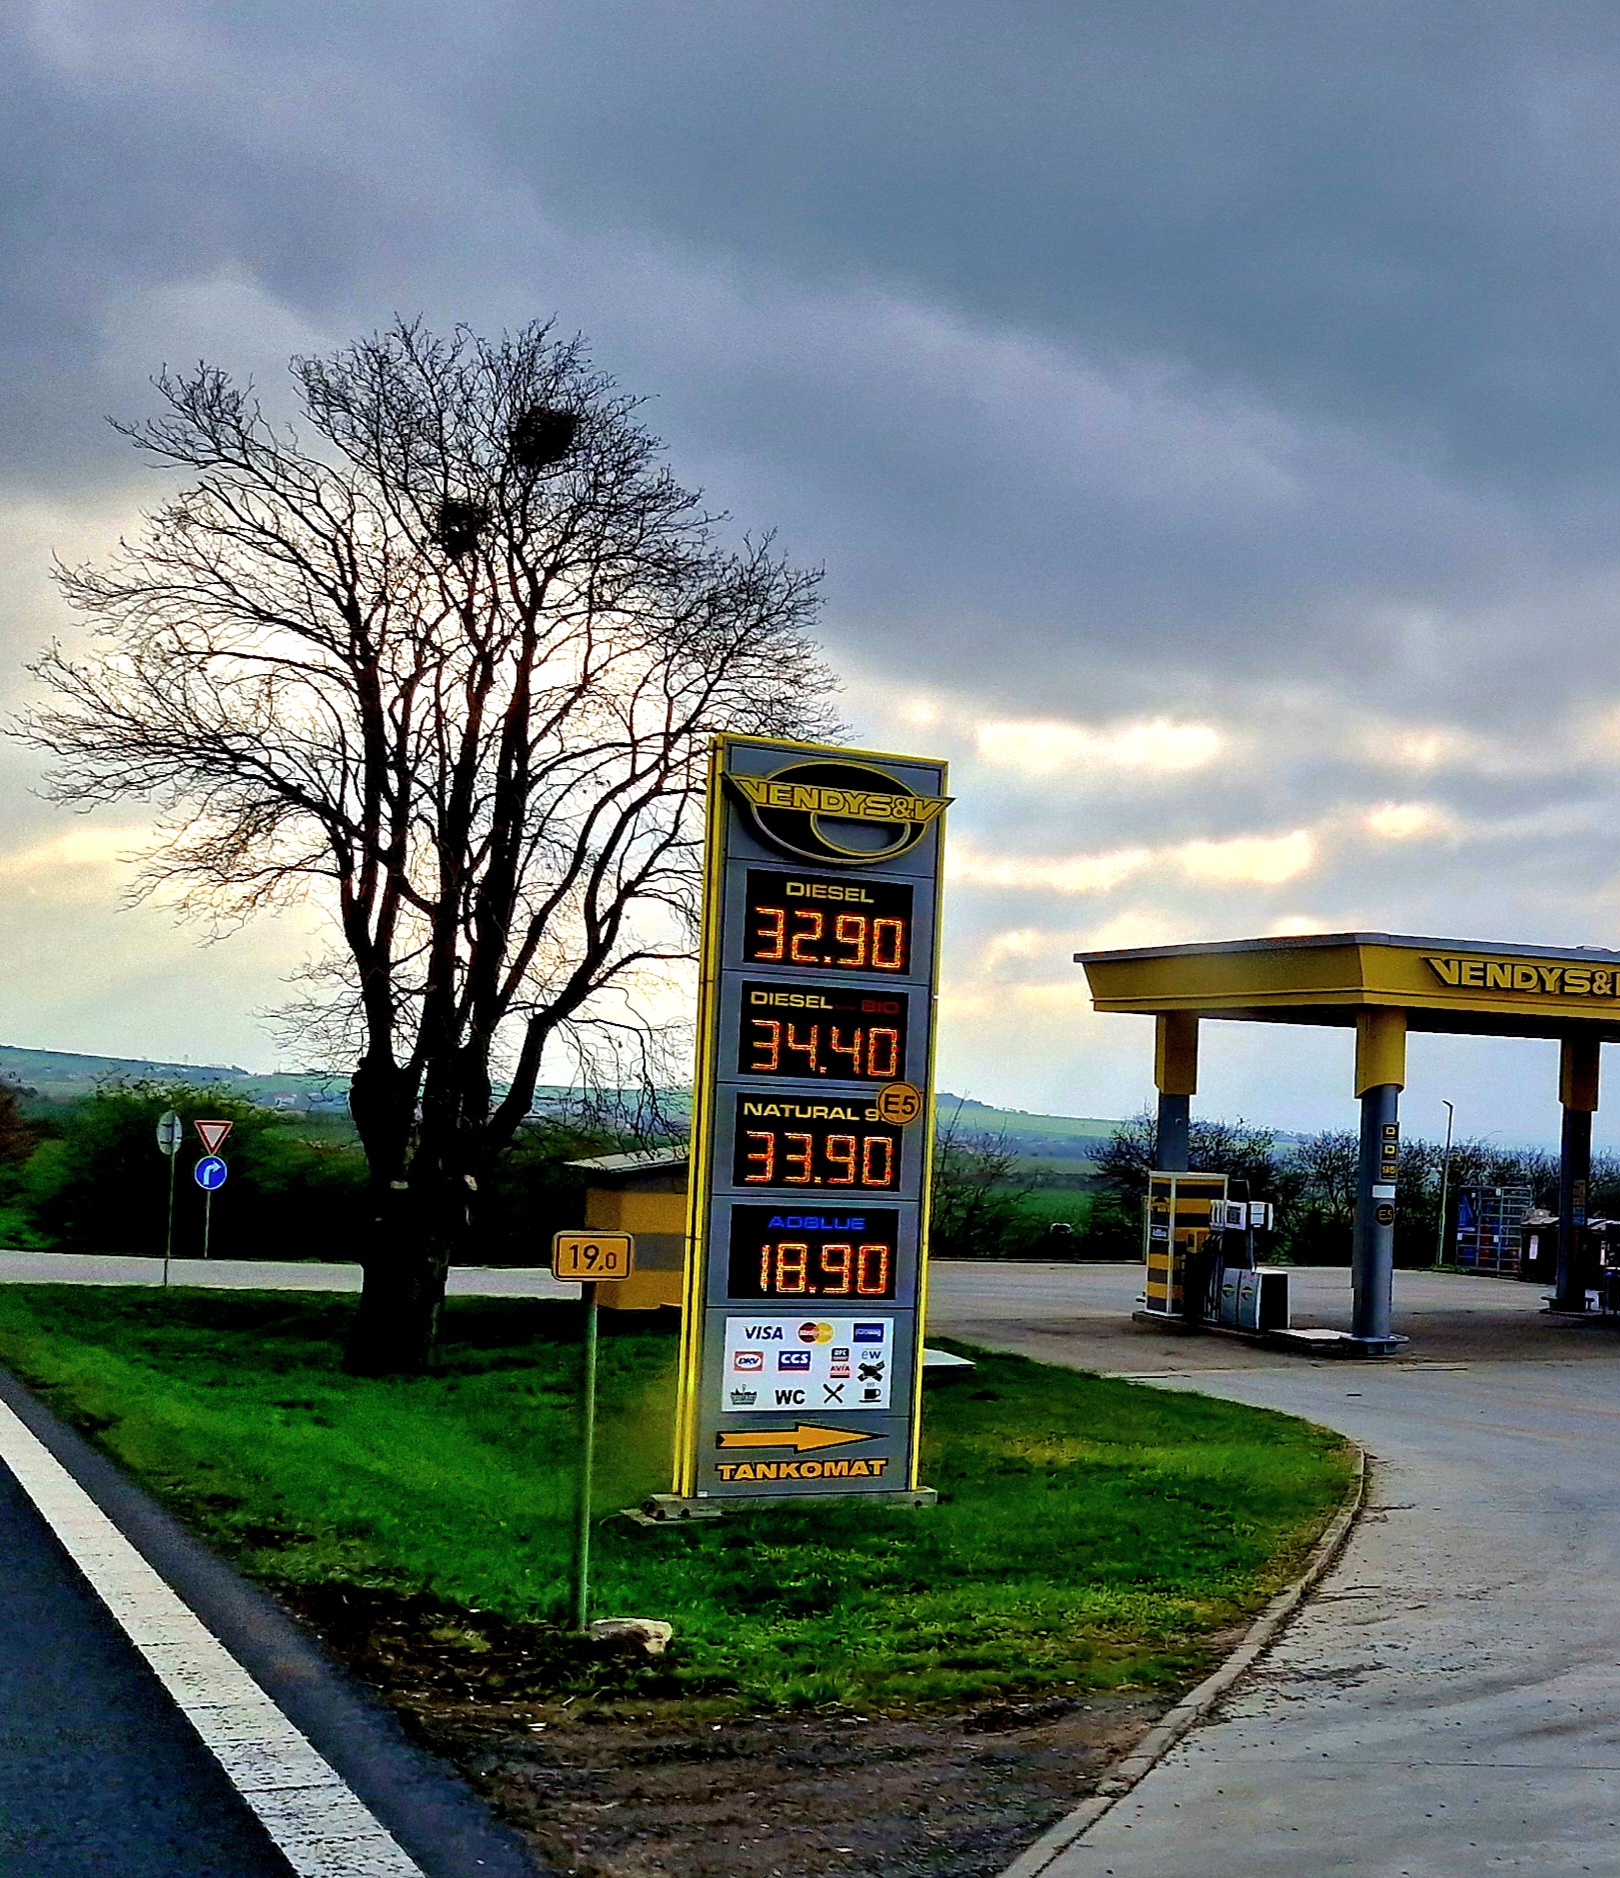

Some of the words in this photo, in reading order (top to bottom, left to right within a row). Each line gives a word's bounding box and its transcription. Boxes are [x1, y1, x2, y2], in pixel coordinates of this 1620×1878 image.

[737, 779, 942, 821] VENDYS&V
[786, 881, 874, 903] DIESEL
[754, 906, 903, 968] 32.90
[750, 991, 833, 1010] DIESEL
[860, 999, 899, 1015] BIO
[751, 1019, 898, 1077] 34.40
[743, 1102, 860, 1121] NATURAL
[884, 1093, 916, 1115] E5
[1385, 1126, 1396, 1136] D
[744, 1130, 893, 1186] 33.90
[1384, 1144, 1396, 1155] D
[768, 1216, 867, 1231] ADBLUE
[760, 1243, 889, 1294] 18.90
[743, 1326, 784, 1340] VISA
[780, 1353, 809, 1364] CCS
[830, 1364, 851, 1372] AVIA
[775, 1389, 806, 1405] WC
[716, 1459, 888, 1481] TANKOMAT
